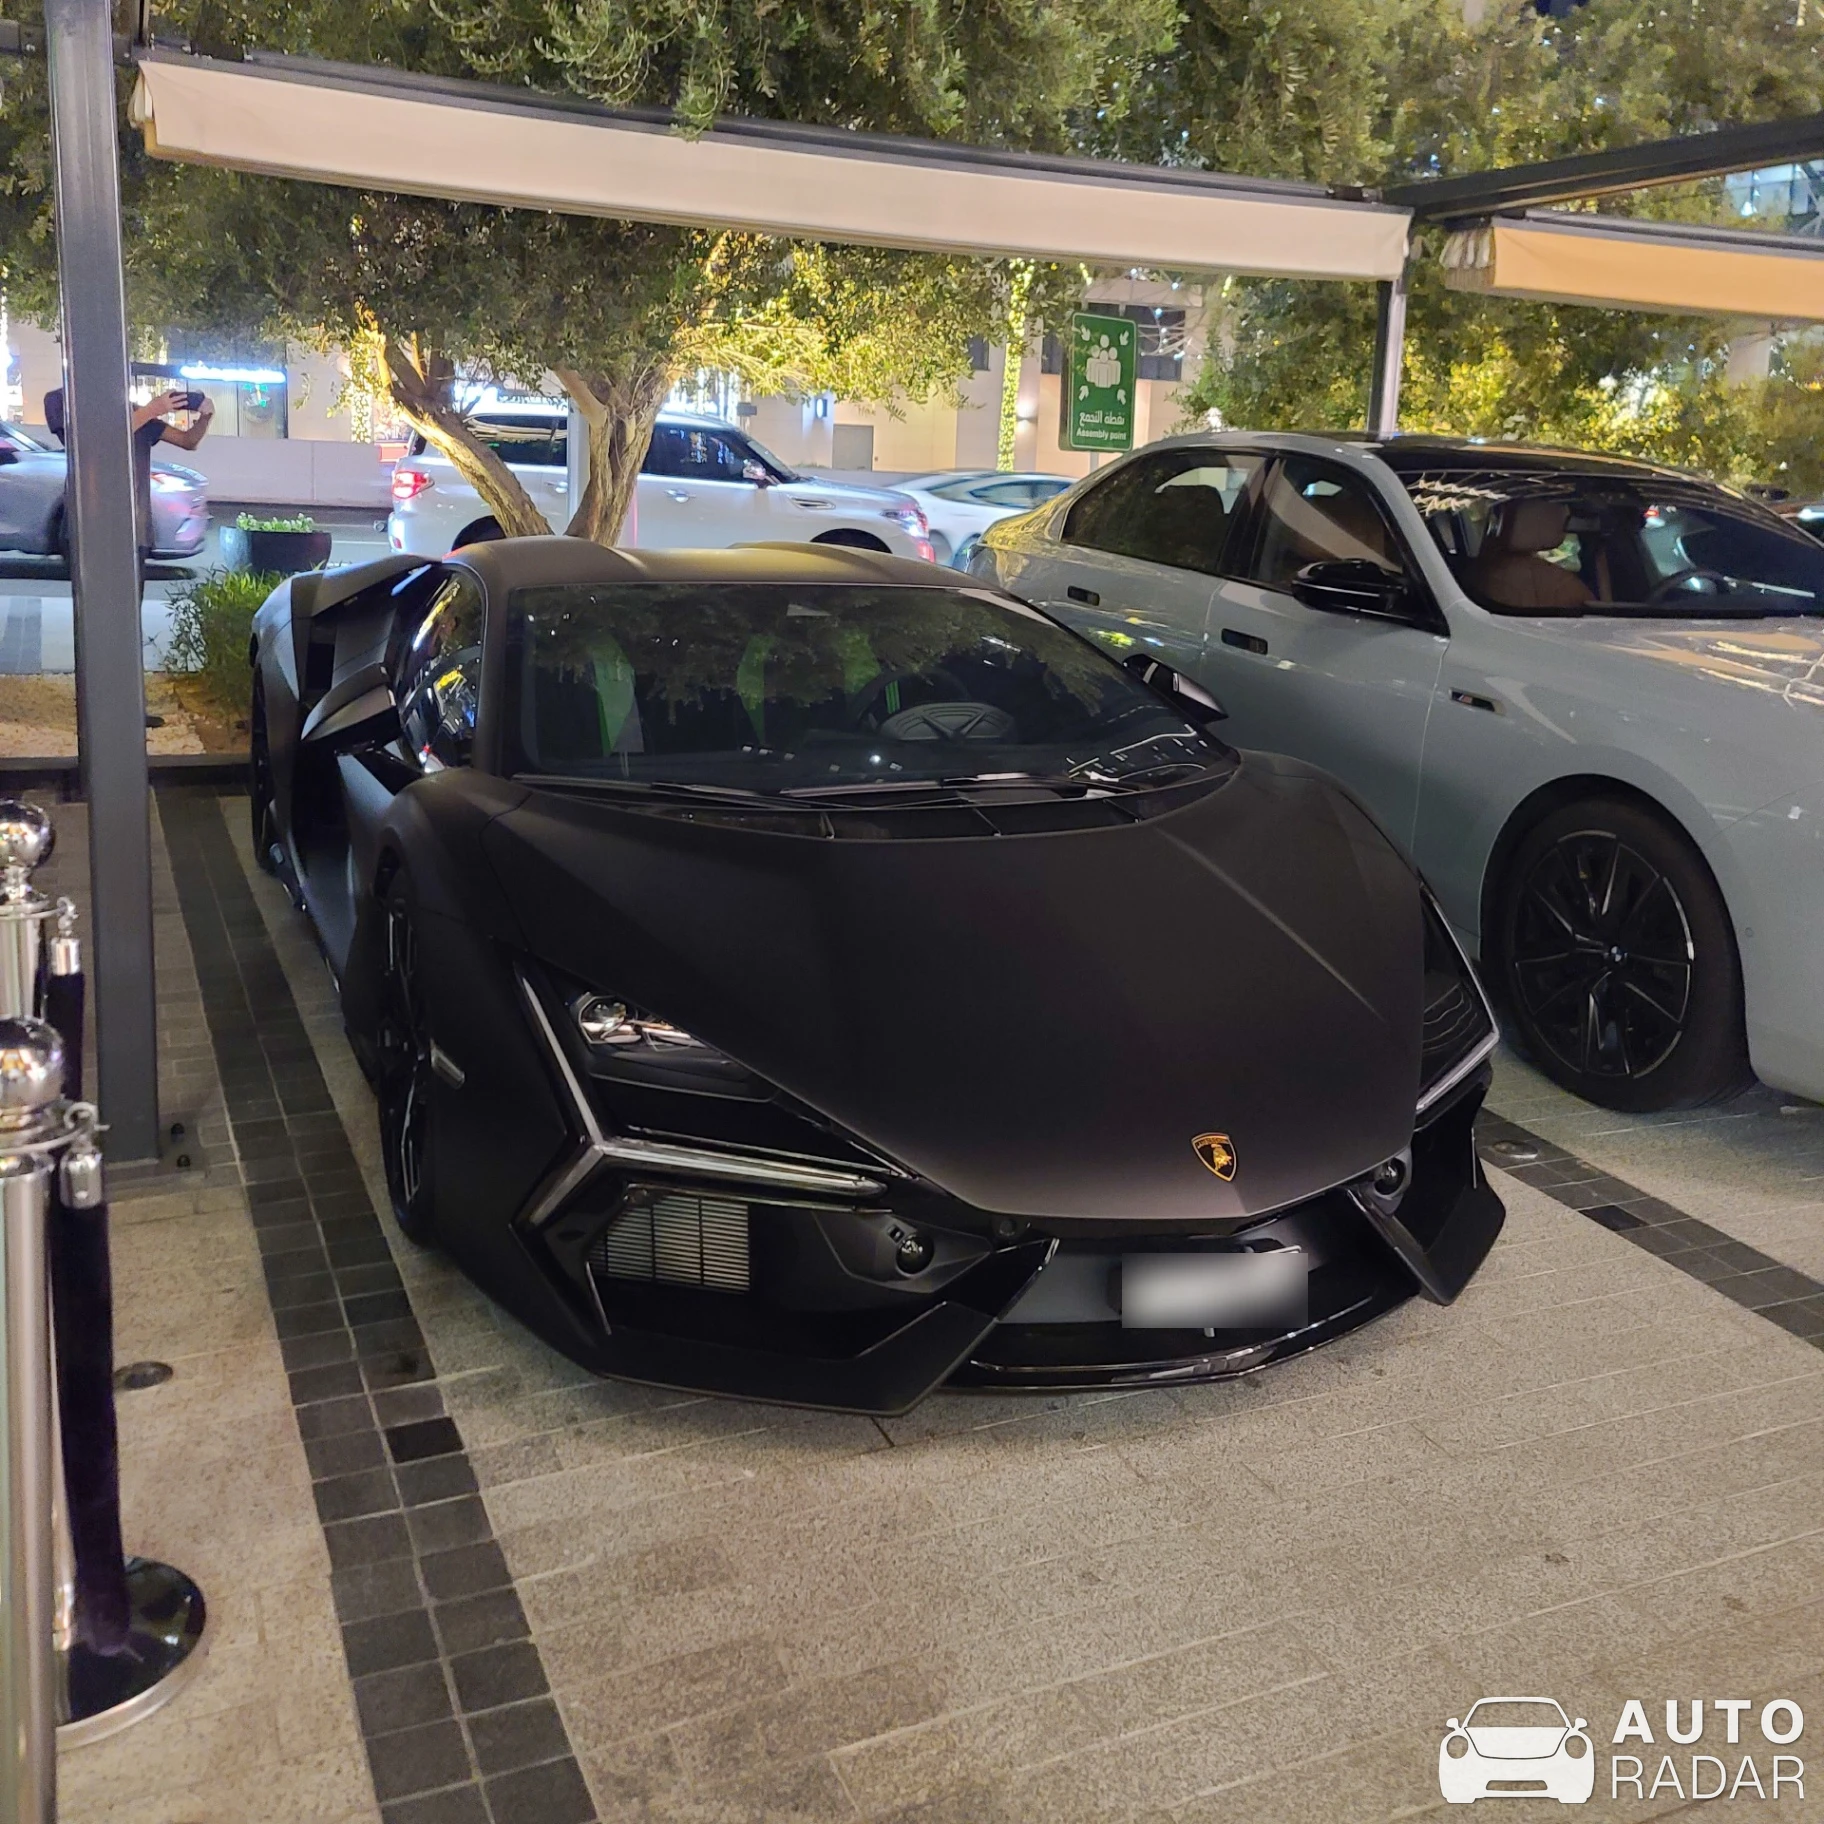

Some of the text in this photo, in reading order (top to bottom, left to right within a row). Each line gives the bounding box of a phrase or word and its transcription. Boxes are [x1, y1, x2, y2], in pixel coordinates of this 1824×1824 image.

[1079, 410, 1125, 426] نقطة التجمع
[1076, 427, 1126, 440] Assembly point
